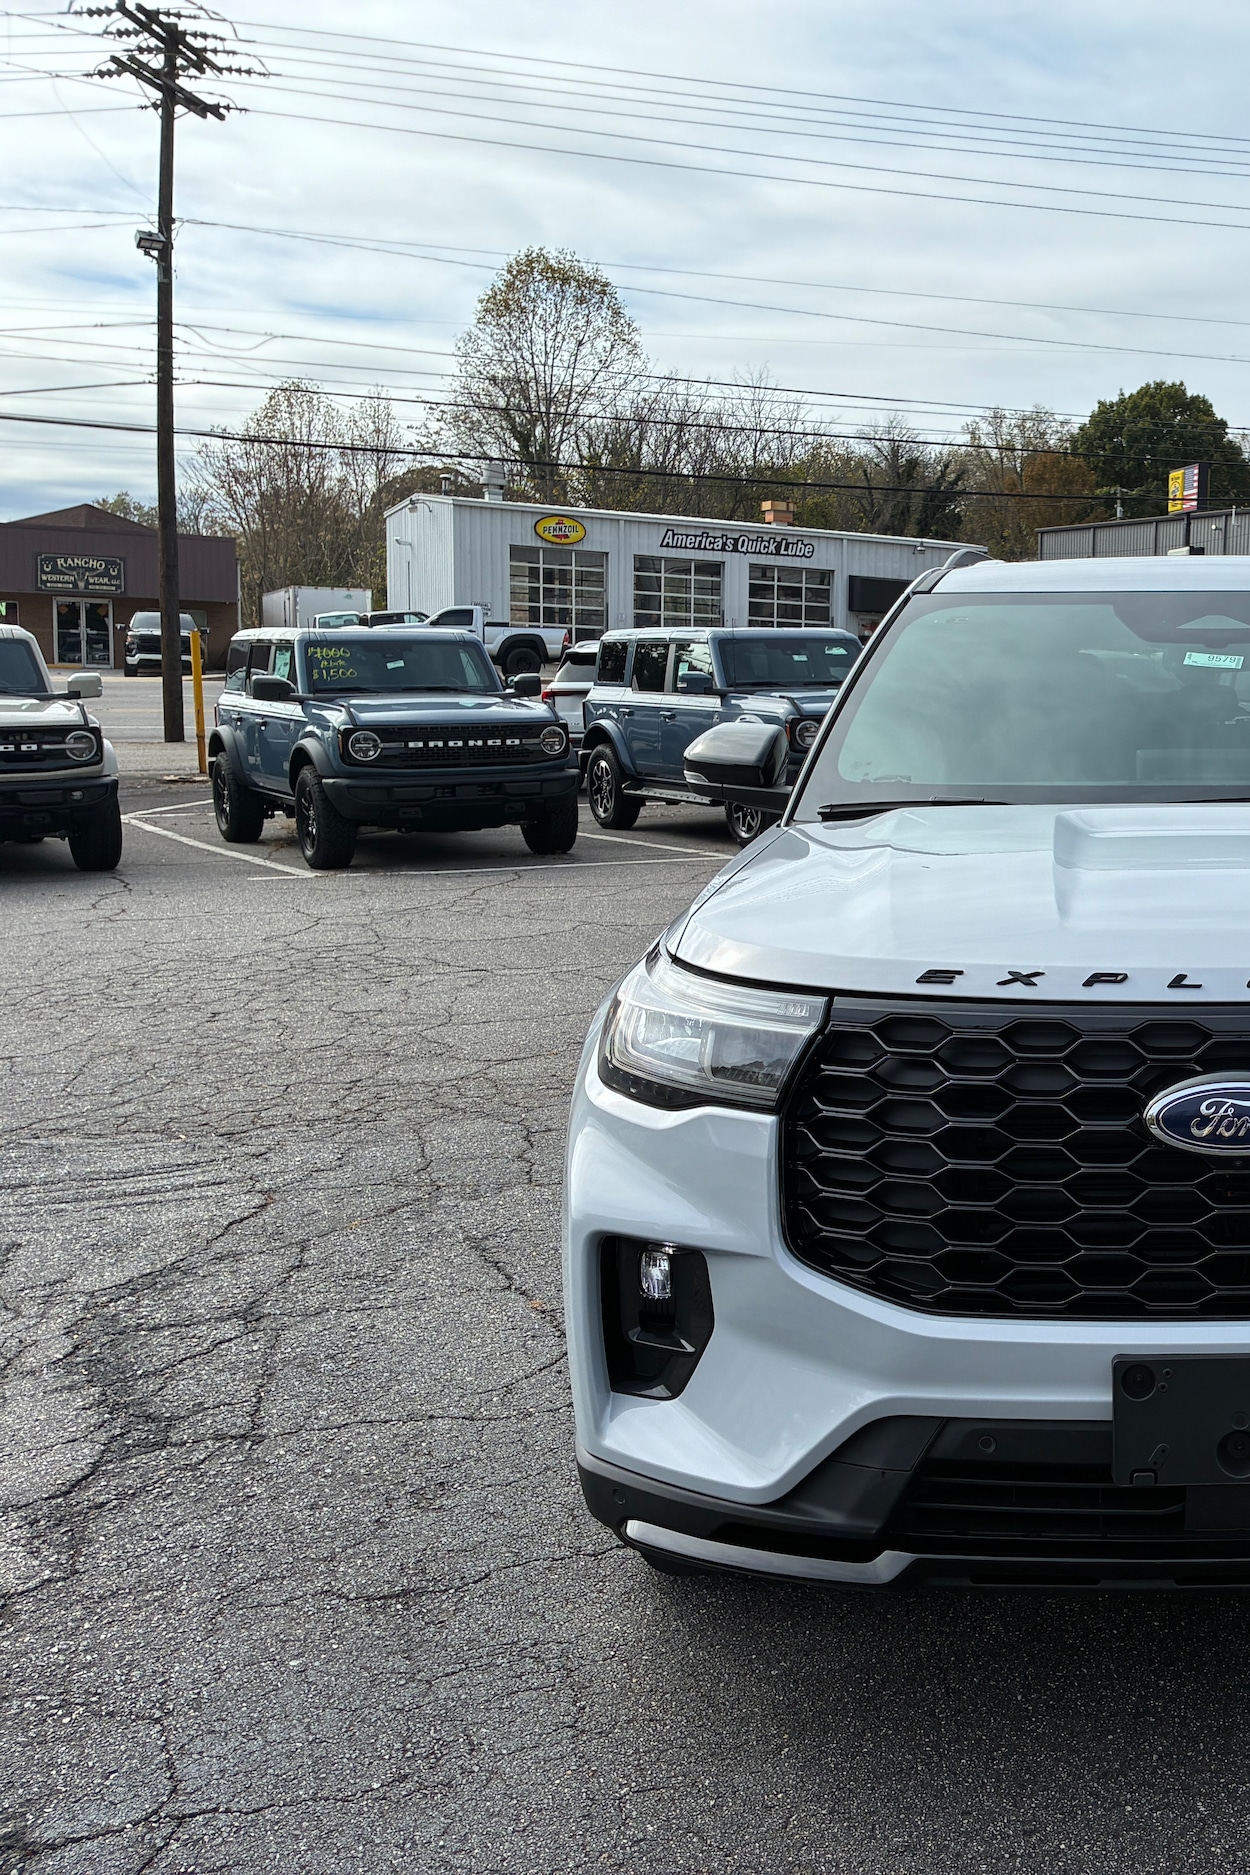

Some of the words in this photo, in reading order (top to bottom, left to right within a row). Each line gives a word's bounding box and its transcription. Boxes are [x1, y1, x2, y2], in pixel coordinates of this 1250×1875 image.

[543, 525, 579, 534] PENNZOIL
[662, 530, 734, 551] America's
[738, 535, 778, 554] Quick
[780, 539, 814, 557] Lube
[56, 557, 105, 570] RANCHO
[41, 574, 75, 582] WESTERN
[1208, 655, 1236, 664] 9579
[408, 739, 520, 748] BRONCO
